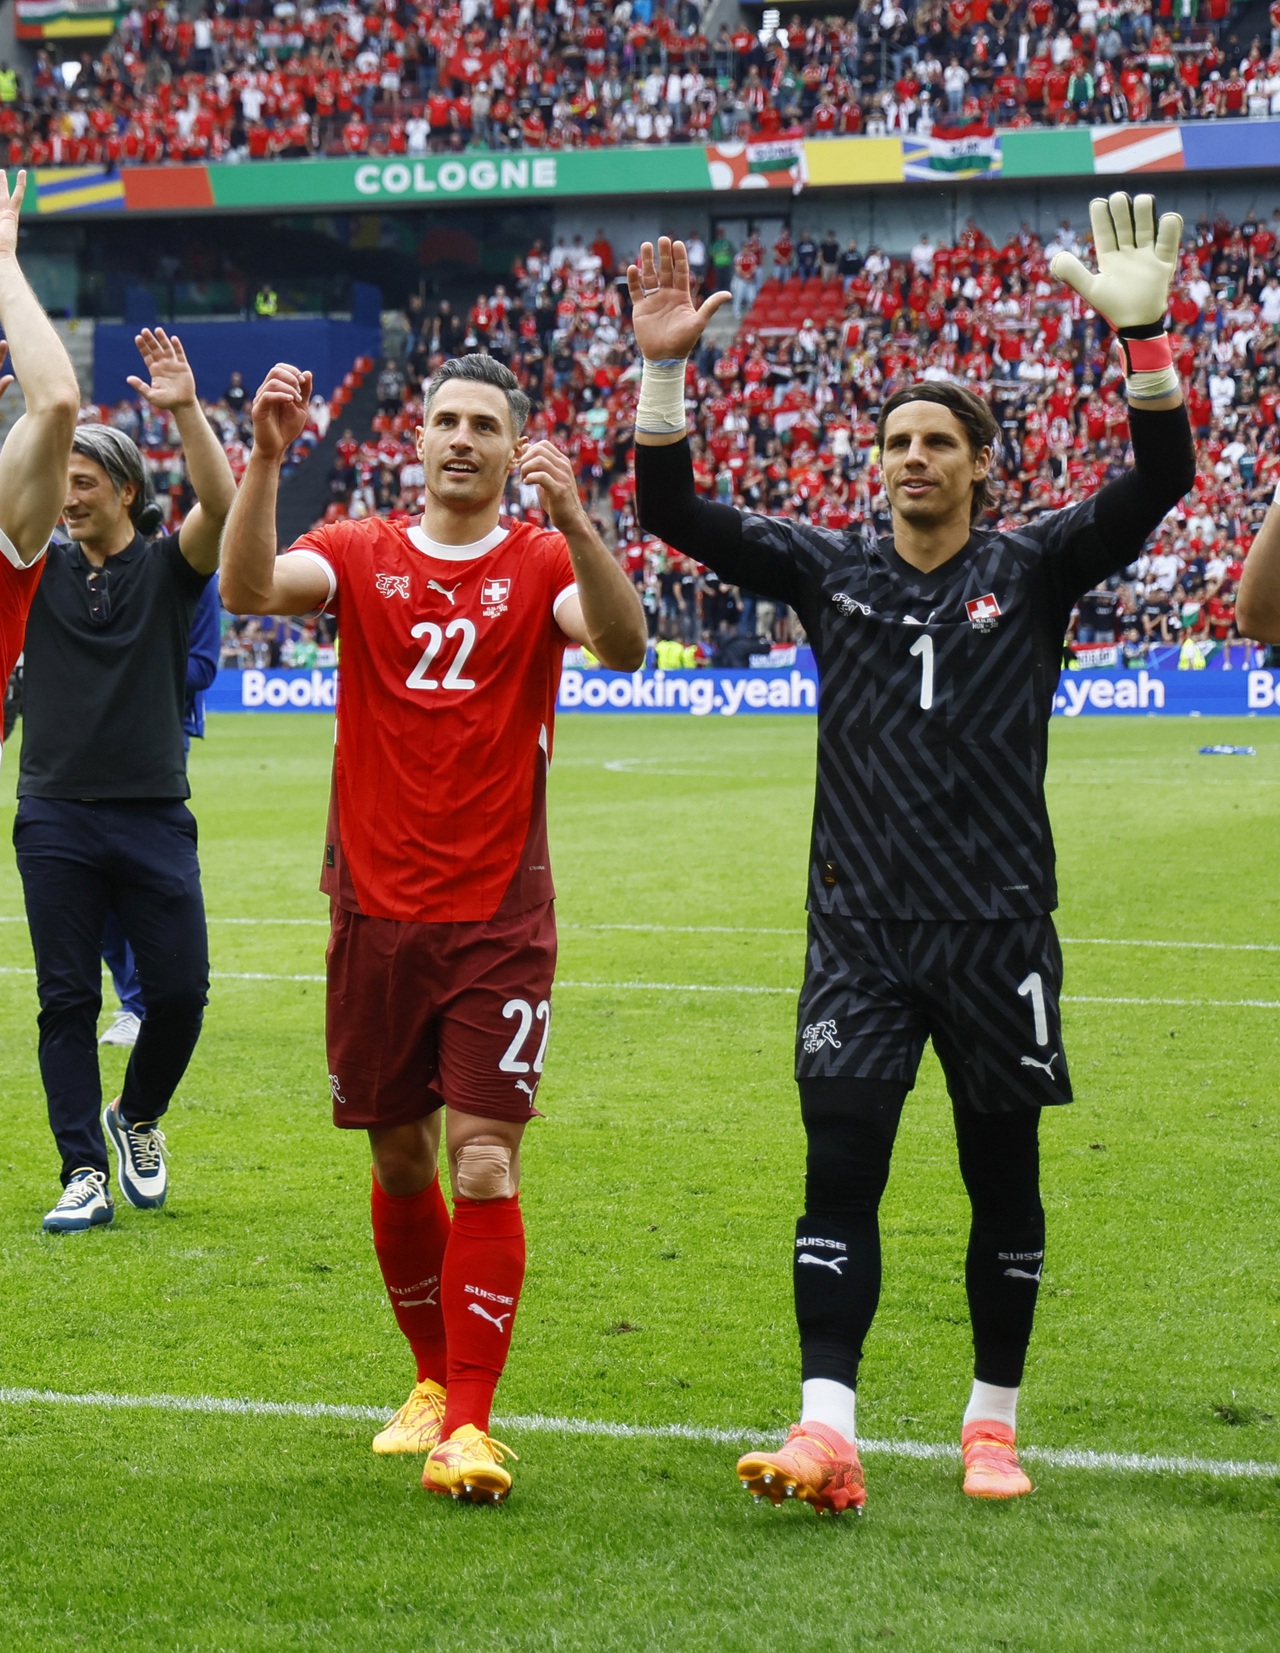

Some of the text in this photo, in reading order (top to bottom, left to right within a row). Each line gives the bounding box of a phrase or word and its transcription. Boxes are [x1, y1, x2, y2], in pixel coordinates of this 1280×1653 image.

[354, 158, 557, 195] COLOGNE
[405, 618, 476, 690] 22
[909, 634, 933, 710] 1
[559, 669, 817, 716] Booking.yeah
[1052, 670, 1165, 717] .yeah
[1247, 670, 1280, 709] B
[1017, 972, 1048, 1046] 1
[498, 998, 550, 1073] 22
[796, 1237, 847, 1251] SUISSE
[998, 1250, 1043, 1261] SUISS
[390, 1275, 438, 1295] SUISSE
[464, 1284, 514, 1305] SUISSE
